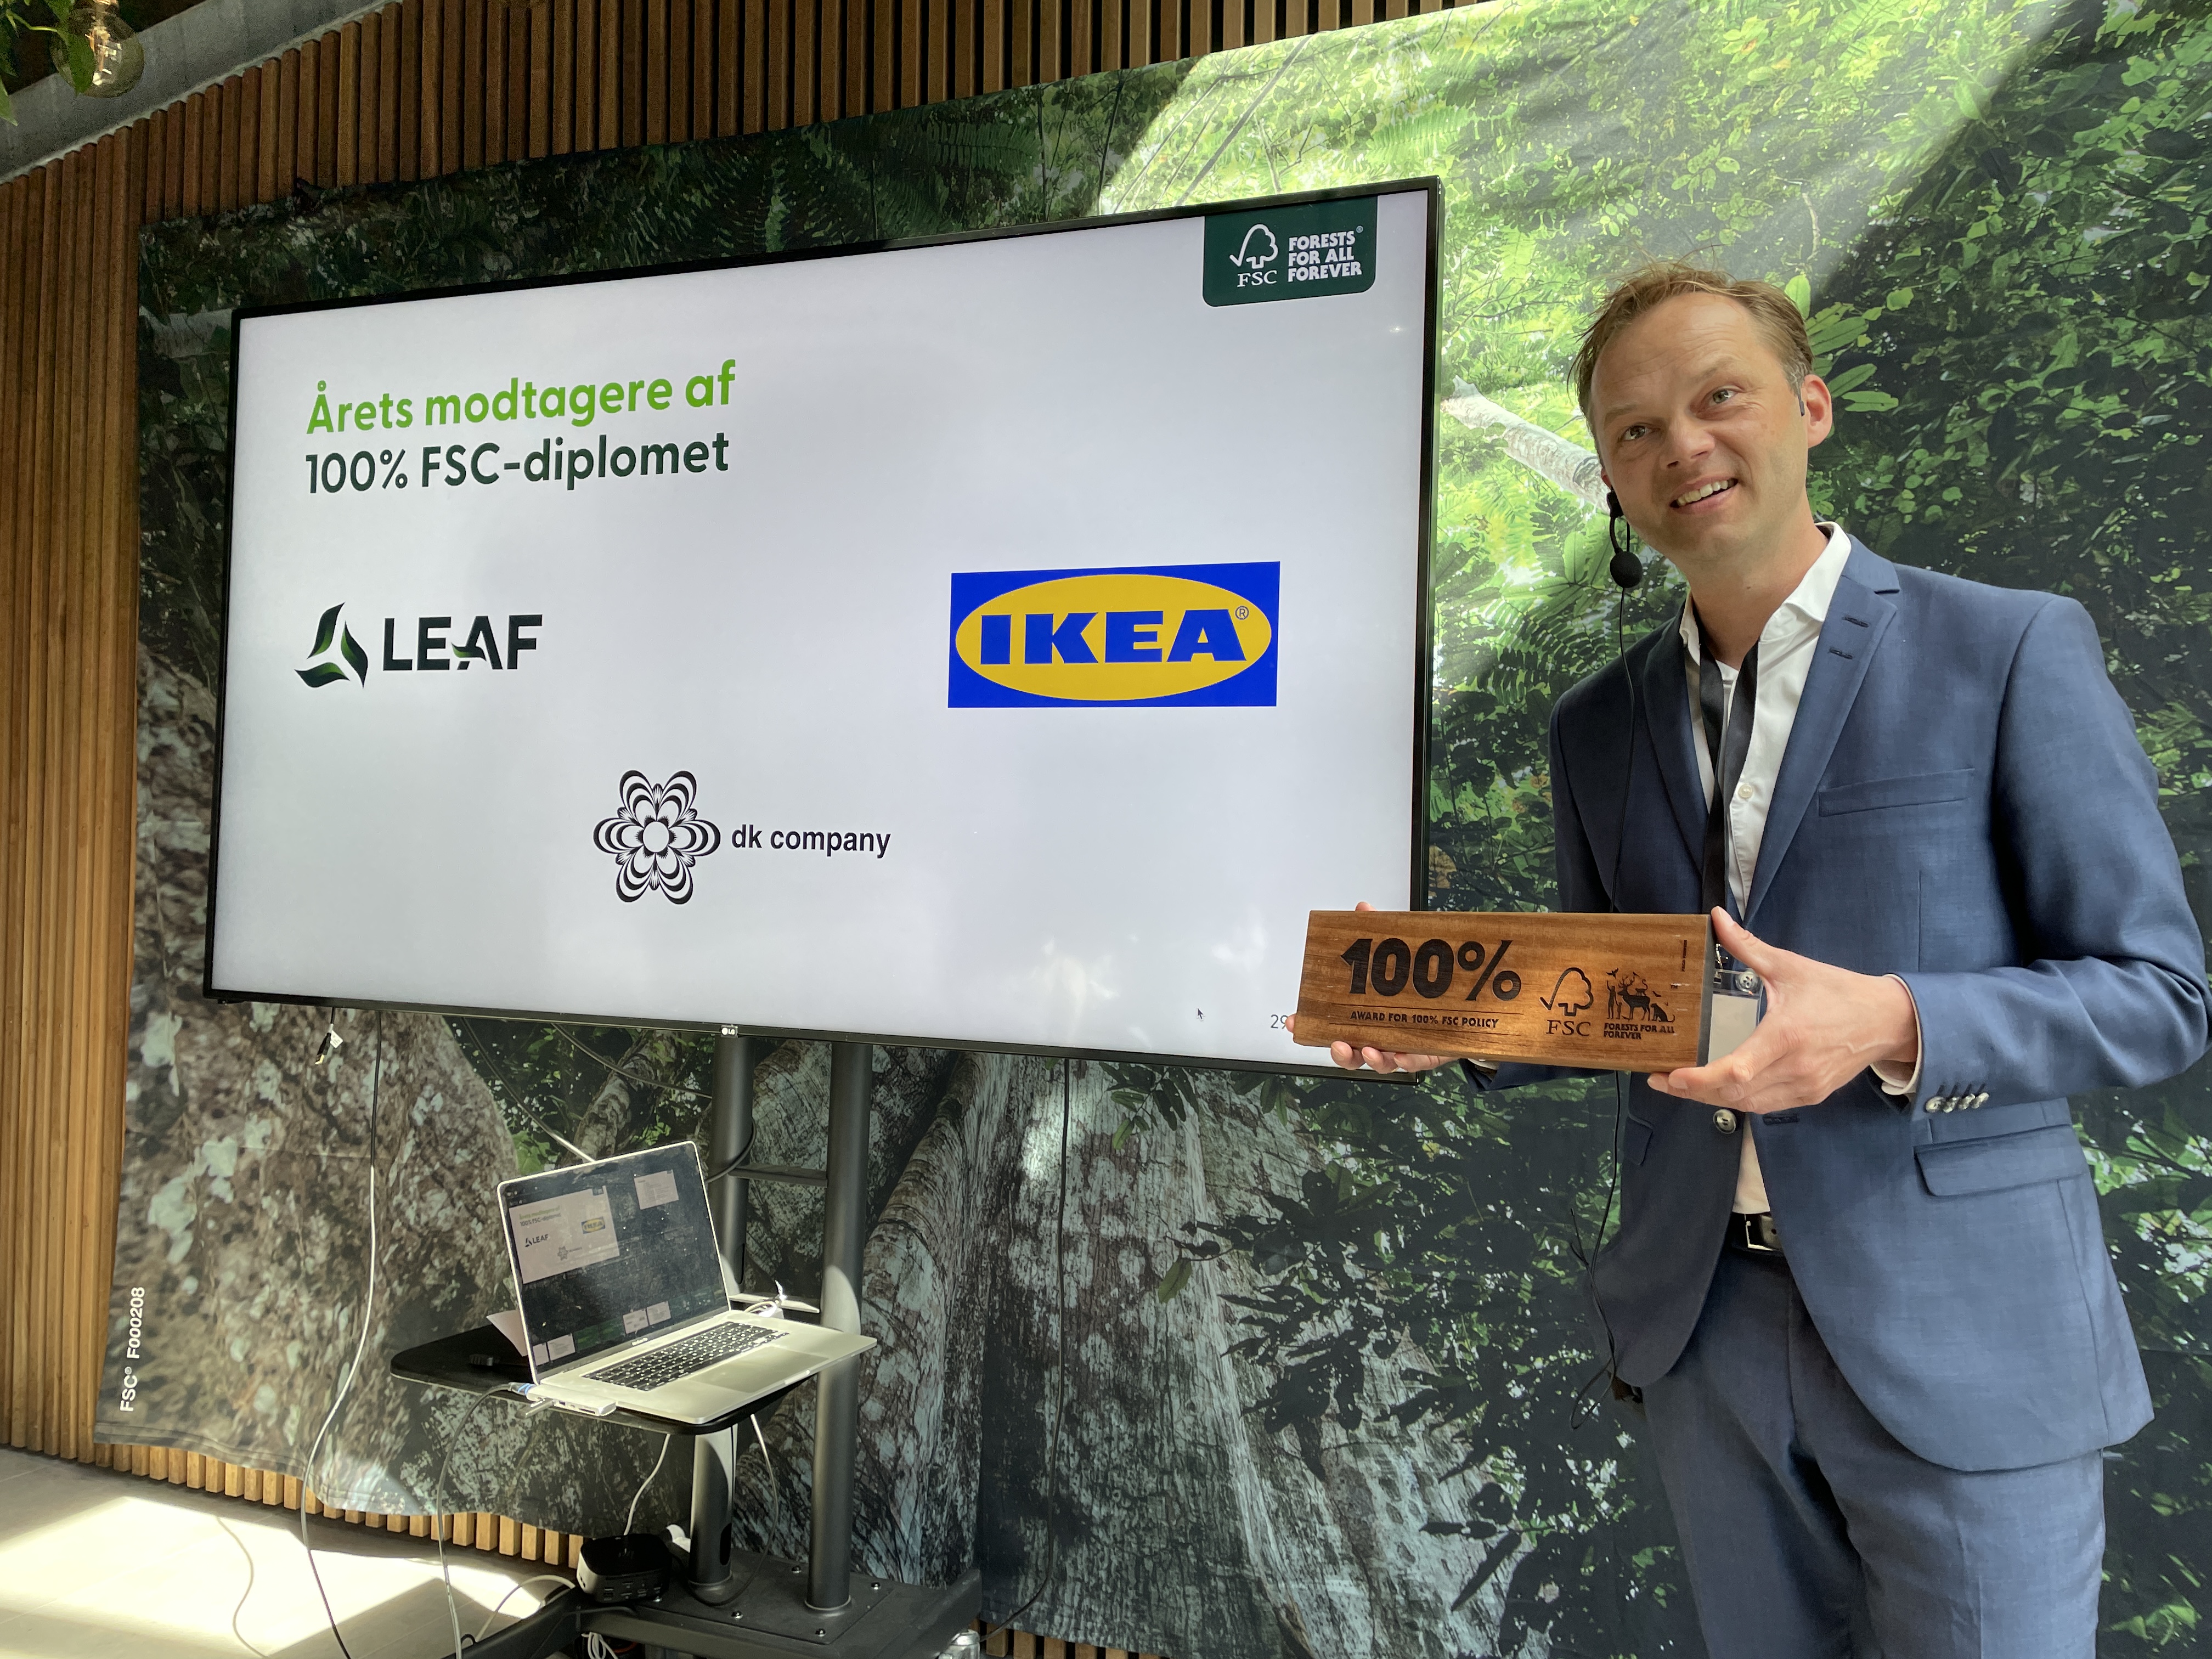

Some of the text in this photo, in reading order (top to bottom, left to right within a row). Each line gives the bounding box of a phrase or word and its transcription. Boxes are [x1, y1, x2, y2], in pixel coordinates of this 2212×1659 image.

[1288, 247, 1355, 267] FOR ALL
[1237, 270, 1277, 287] FSC
[1288, 262, 1362, 283] FOREVER
[306, 359, 736, 435] Årets modtagere af
[305, 432, 729, 494] 100% FSC-diplomet
[383, 614, 543, 671] LEAF
[731, 824, 891, 859] dk company
[1340, 938, 1522, 1001] 100%
[1350, 1011, 1499, 1028] AWARD FOR 100% FSC POLICY
[1545, 1019, 1591, 1037] FSC
[1604, 1023, 1675, 1034] FORESTS FOR ALL
[1604, 1031, 1641, 1040] FOREVER
[532, 1234, 549, 1244] LEAF
[126, 1286, 145, 1359] F000208
